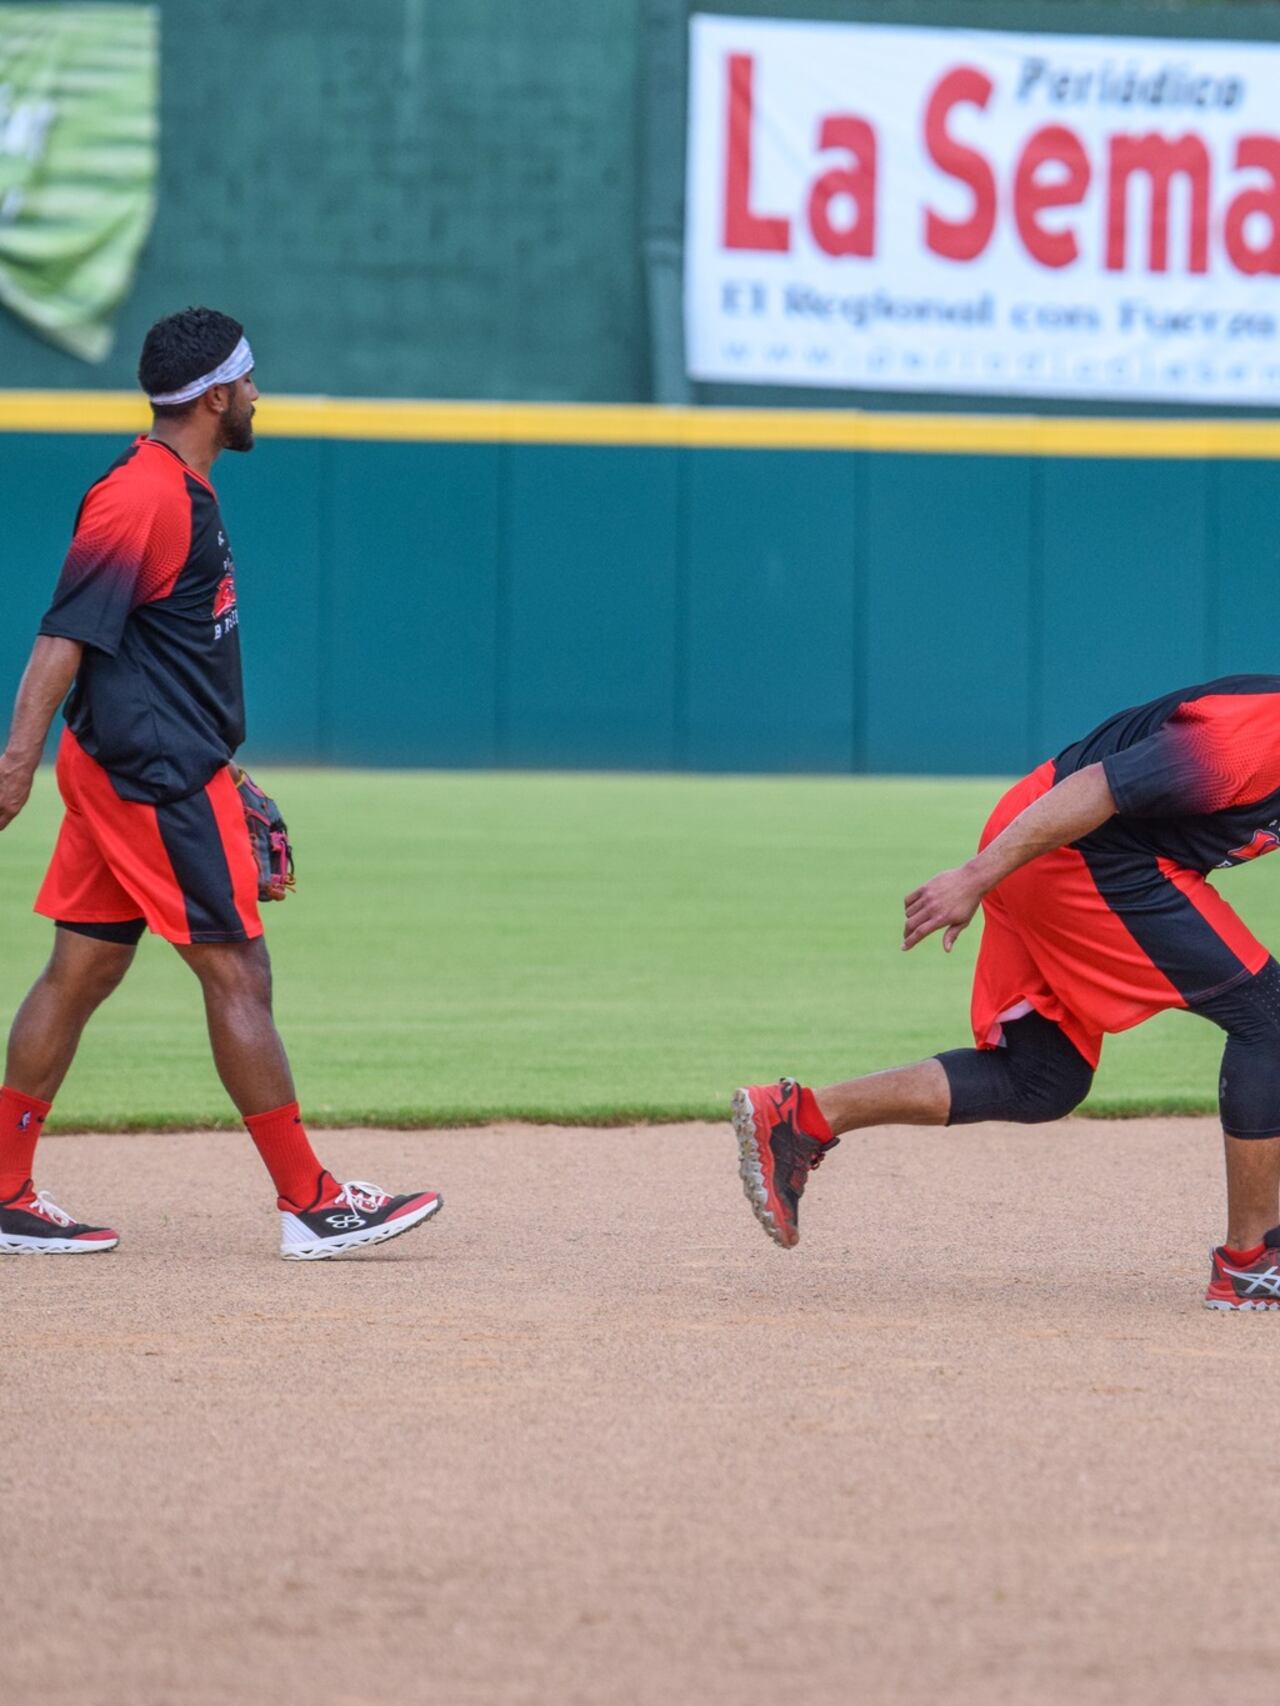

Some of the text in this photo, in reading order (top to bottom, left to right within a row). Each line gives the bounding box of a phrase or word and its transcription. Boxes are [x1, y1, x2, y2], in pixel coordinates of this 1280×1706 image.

[1016, 55, 1247, 110] Periódico
[722, 52, 878, 259] La
[720, 280, 767, 317] El
[783, 284, 995, 331] Regional
[1010, 304, 1102, 334] con
